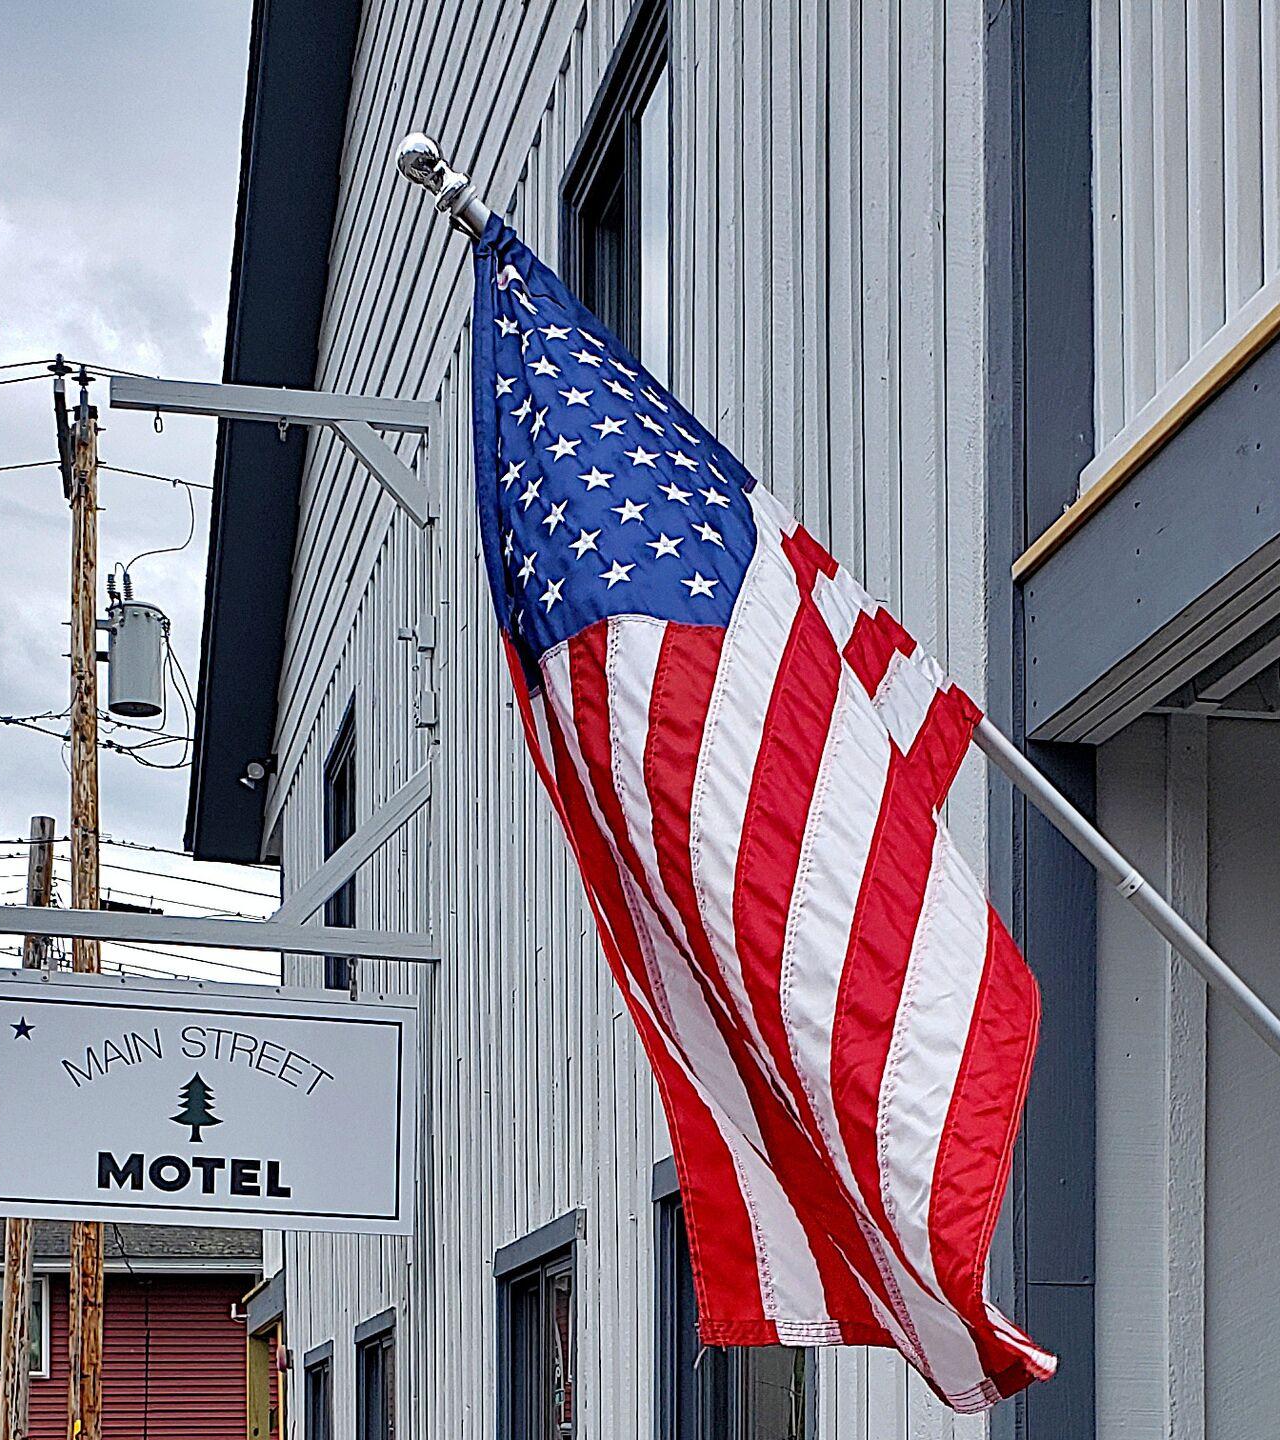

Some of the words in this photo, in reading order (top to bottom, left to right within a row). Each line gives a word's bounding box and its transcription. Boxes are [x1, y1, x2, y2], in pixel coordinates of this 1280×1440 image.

[61, 1027, 163, 1088] MAIN
[180, 1025, 335, 1096] STREET
[97, 1151, 292, 1198] MOTEL
